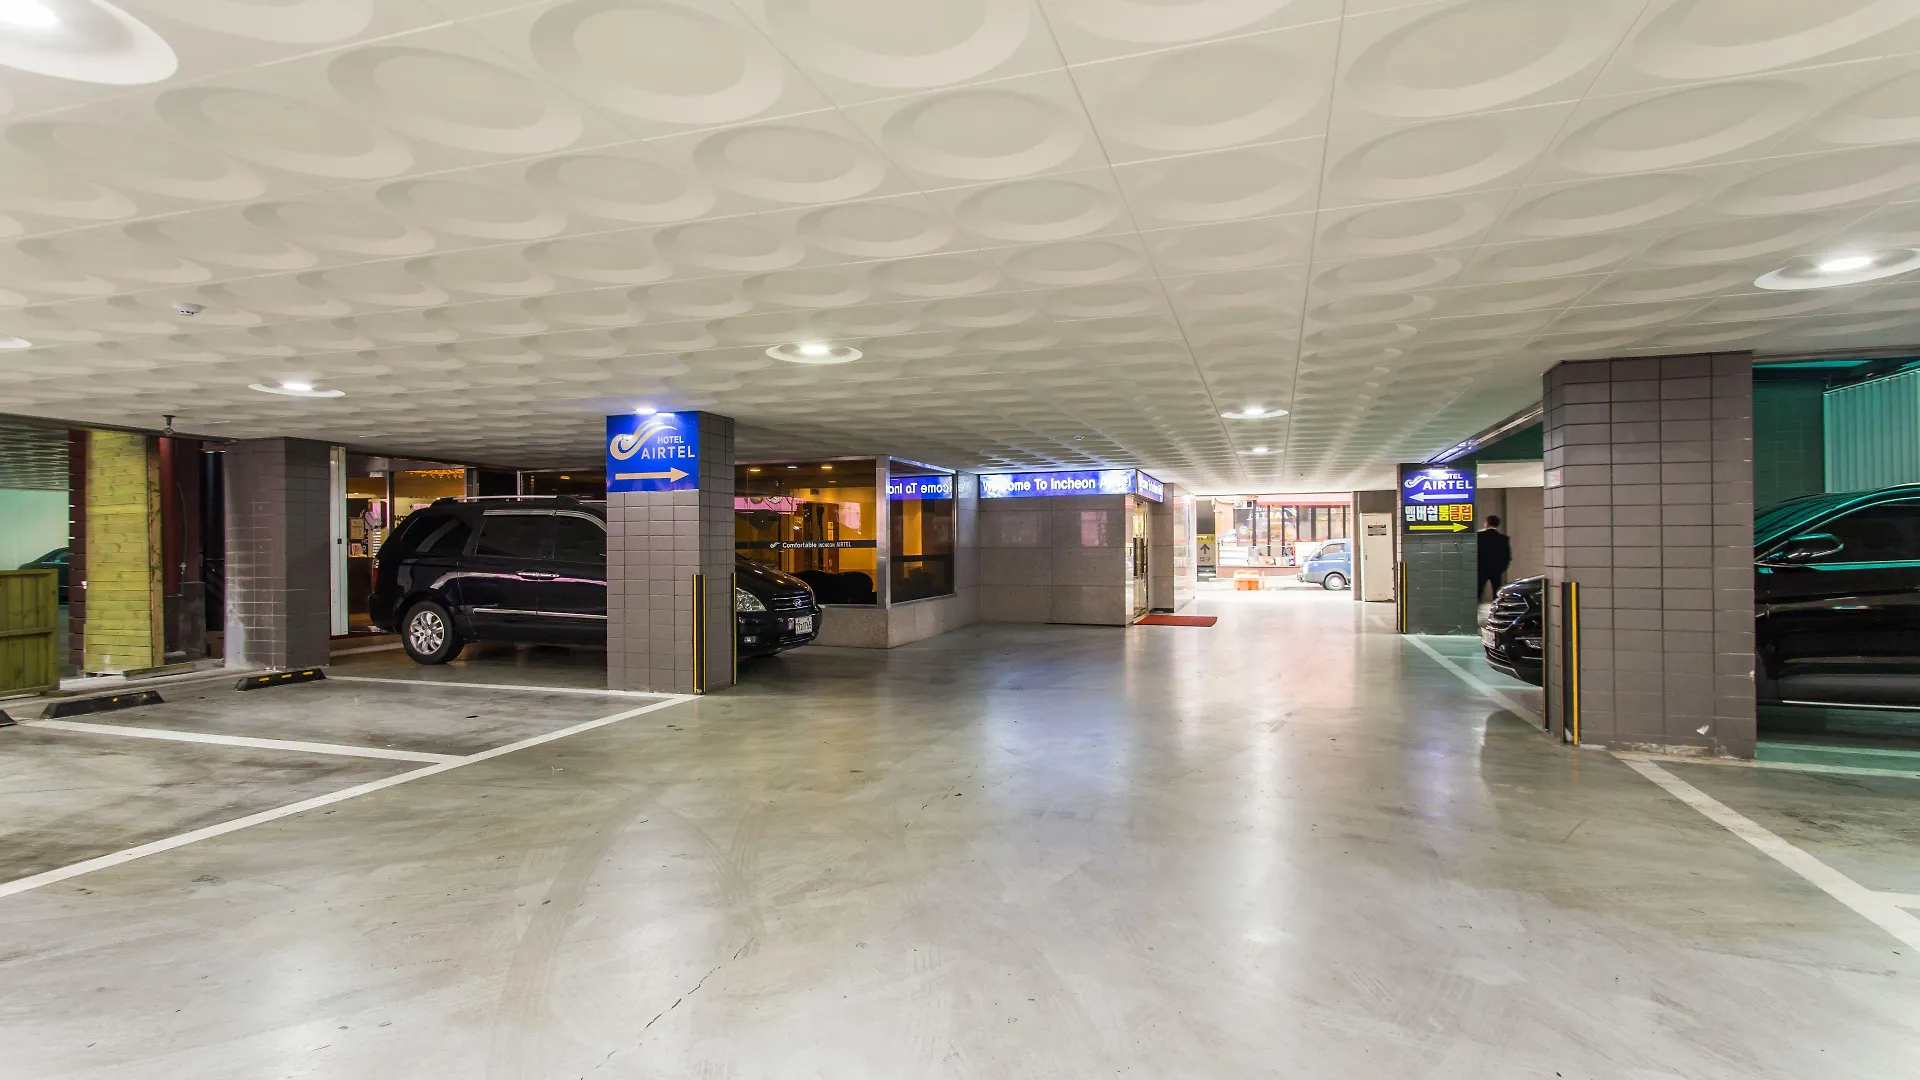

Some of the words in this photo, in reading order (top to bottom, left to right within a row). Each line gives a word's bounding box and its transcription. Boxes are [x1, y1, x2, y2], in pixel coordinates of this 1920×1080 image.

[657, 436, 684, 444] HOTEL
[641, 446, 695, 460] AIRTEL
[1034, 478, 1048, 491] To
[1051, 476, 1096, 490] Incheon
[1423, 480, 1473, 490] AIRTEL
